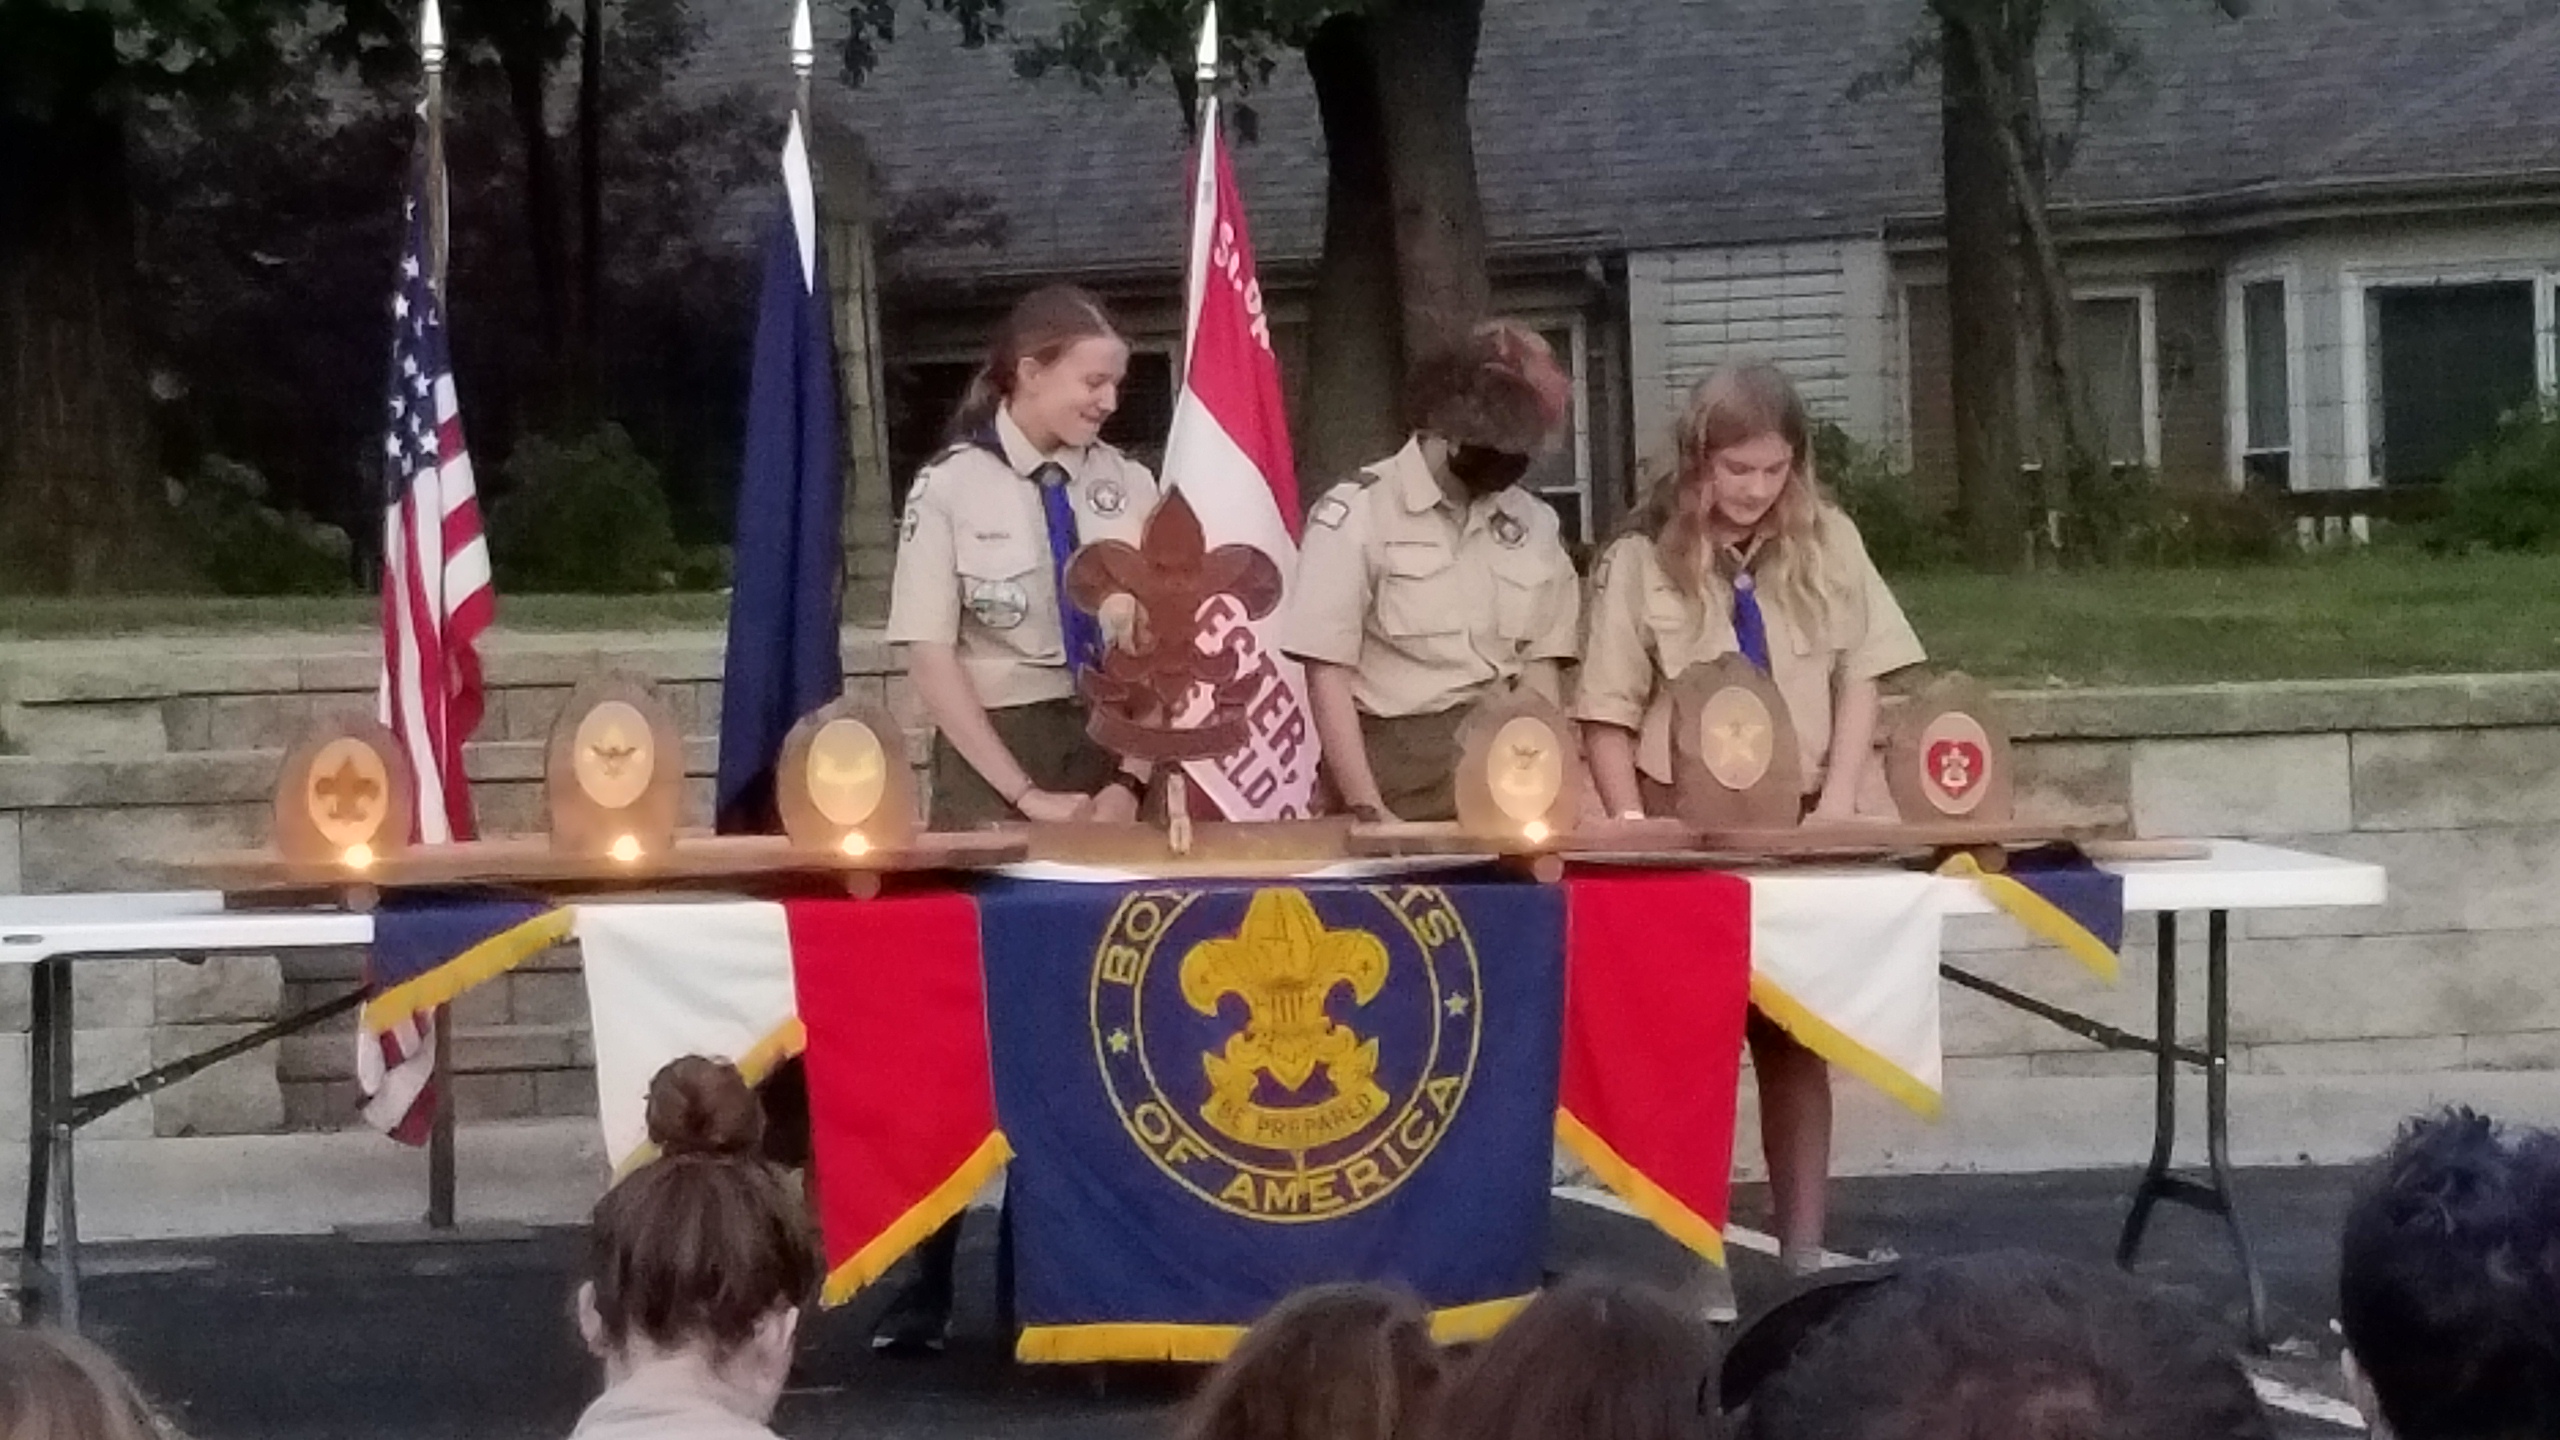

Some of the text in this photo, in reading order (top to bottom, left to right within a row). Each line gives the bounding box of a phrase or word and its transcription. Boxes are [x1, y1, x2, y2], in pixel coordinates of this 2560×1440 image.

[1101, 890, 1183, 986] BO
[1134, 1076, 1461, 1213] OF AMERICA
[1217, 1092, 1372, 1140] BE PREPARED
